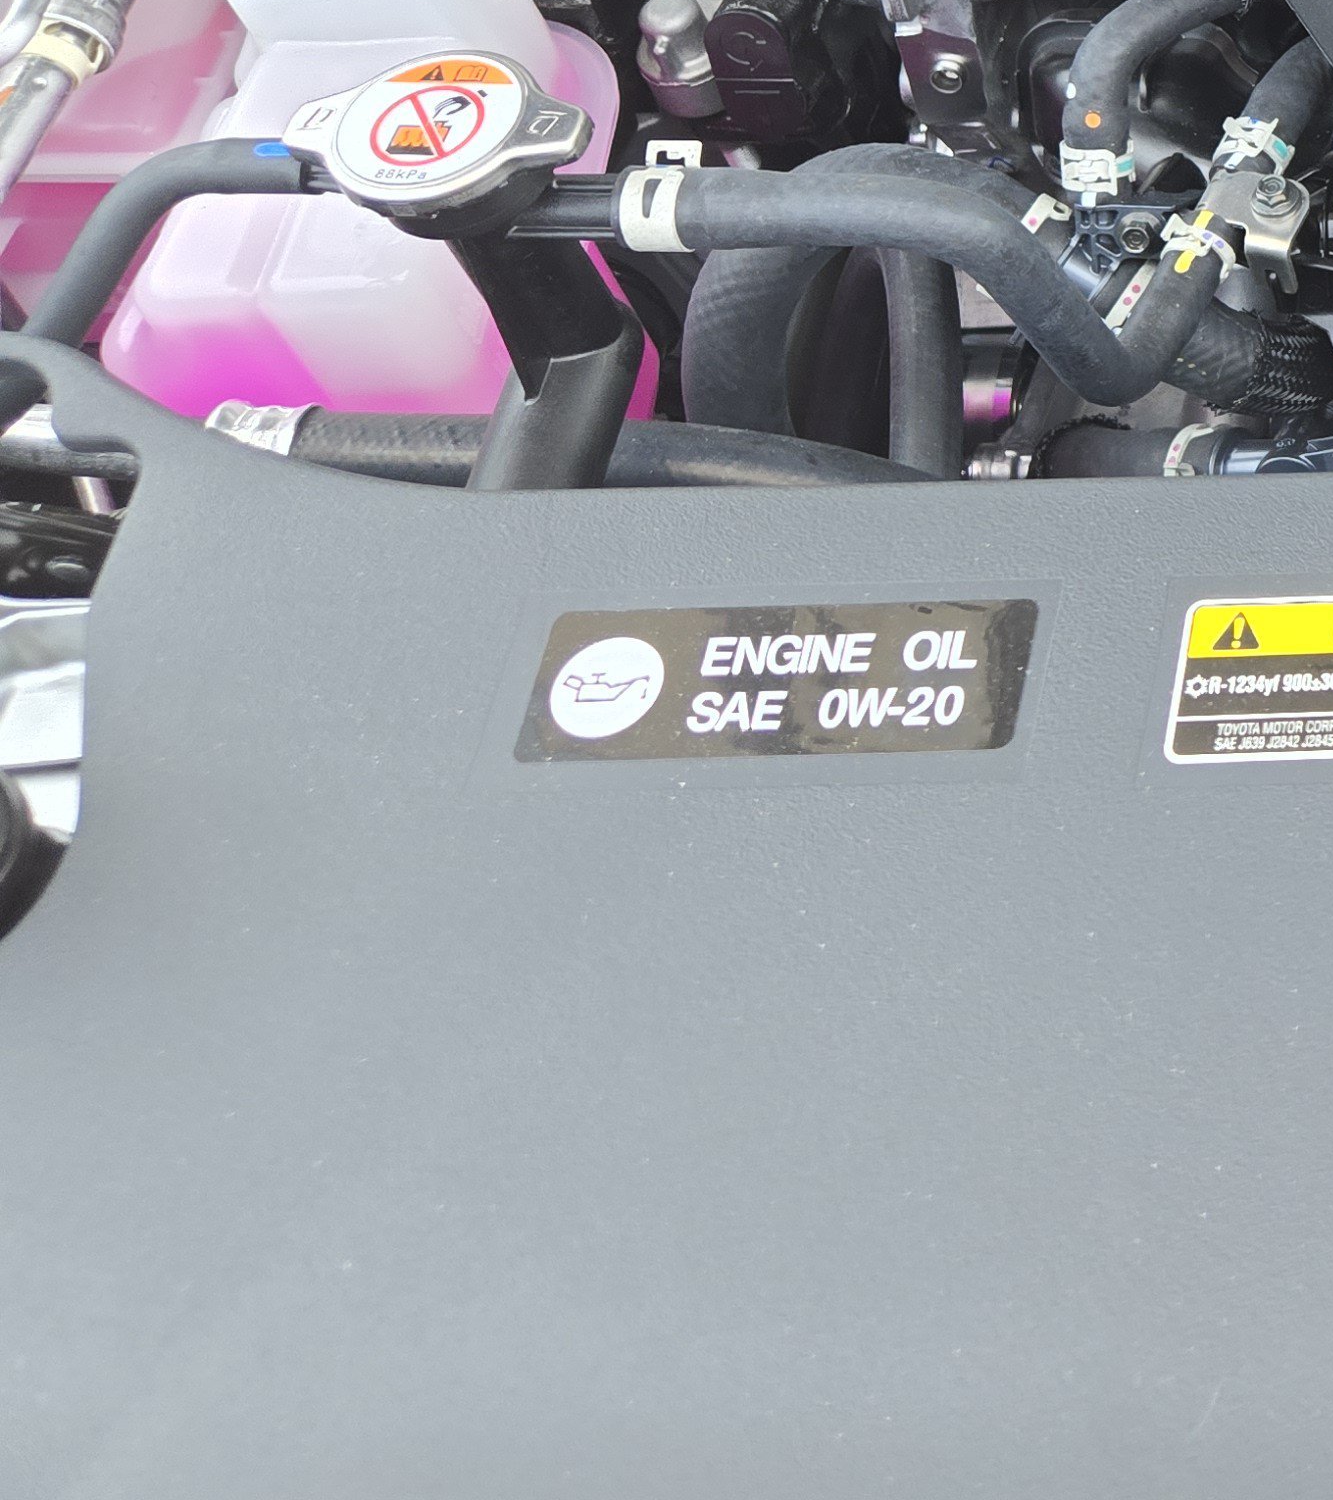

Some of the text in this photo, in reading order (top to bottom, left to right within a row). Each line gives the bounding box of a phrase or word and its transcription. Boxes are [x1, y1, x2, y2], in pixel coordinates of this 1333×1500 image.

[374, 168, 427, 180] 88kPa
[700, 630, 978, 677] ENGINE OIL
[1208, 673, 1280, 696] R-1234yf
[686, 685, 965, 733] SAE 0W-20
[1217, 721, 1260, 737] TOYOTA
[1263, 720, 1304, 735] MOTOR
[1213, 735, 1238, 751] SAE
[1238, 735, 1266, 750] J639
[1267, 734, 1301, 749] J2842
